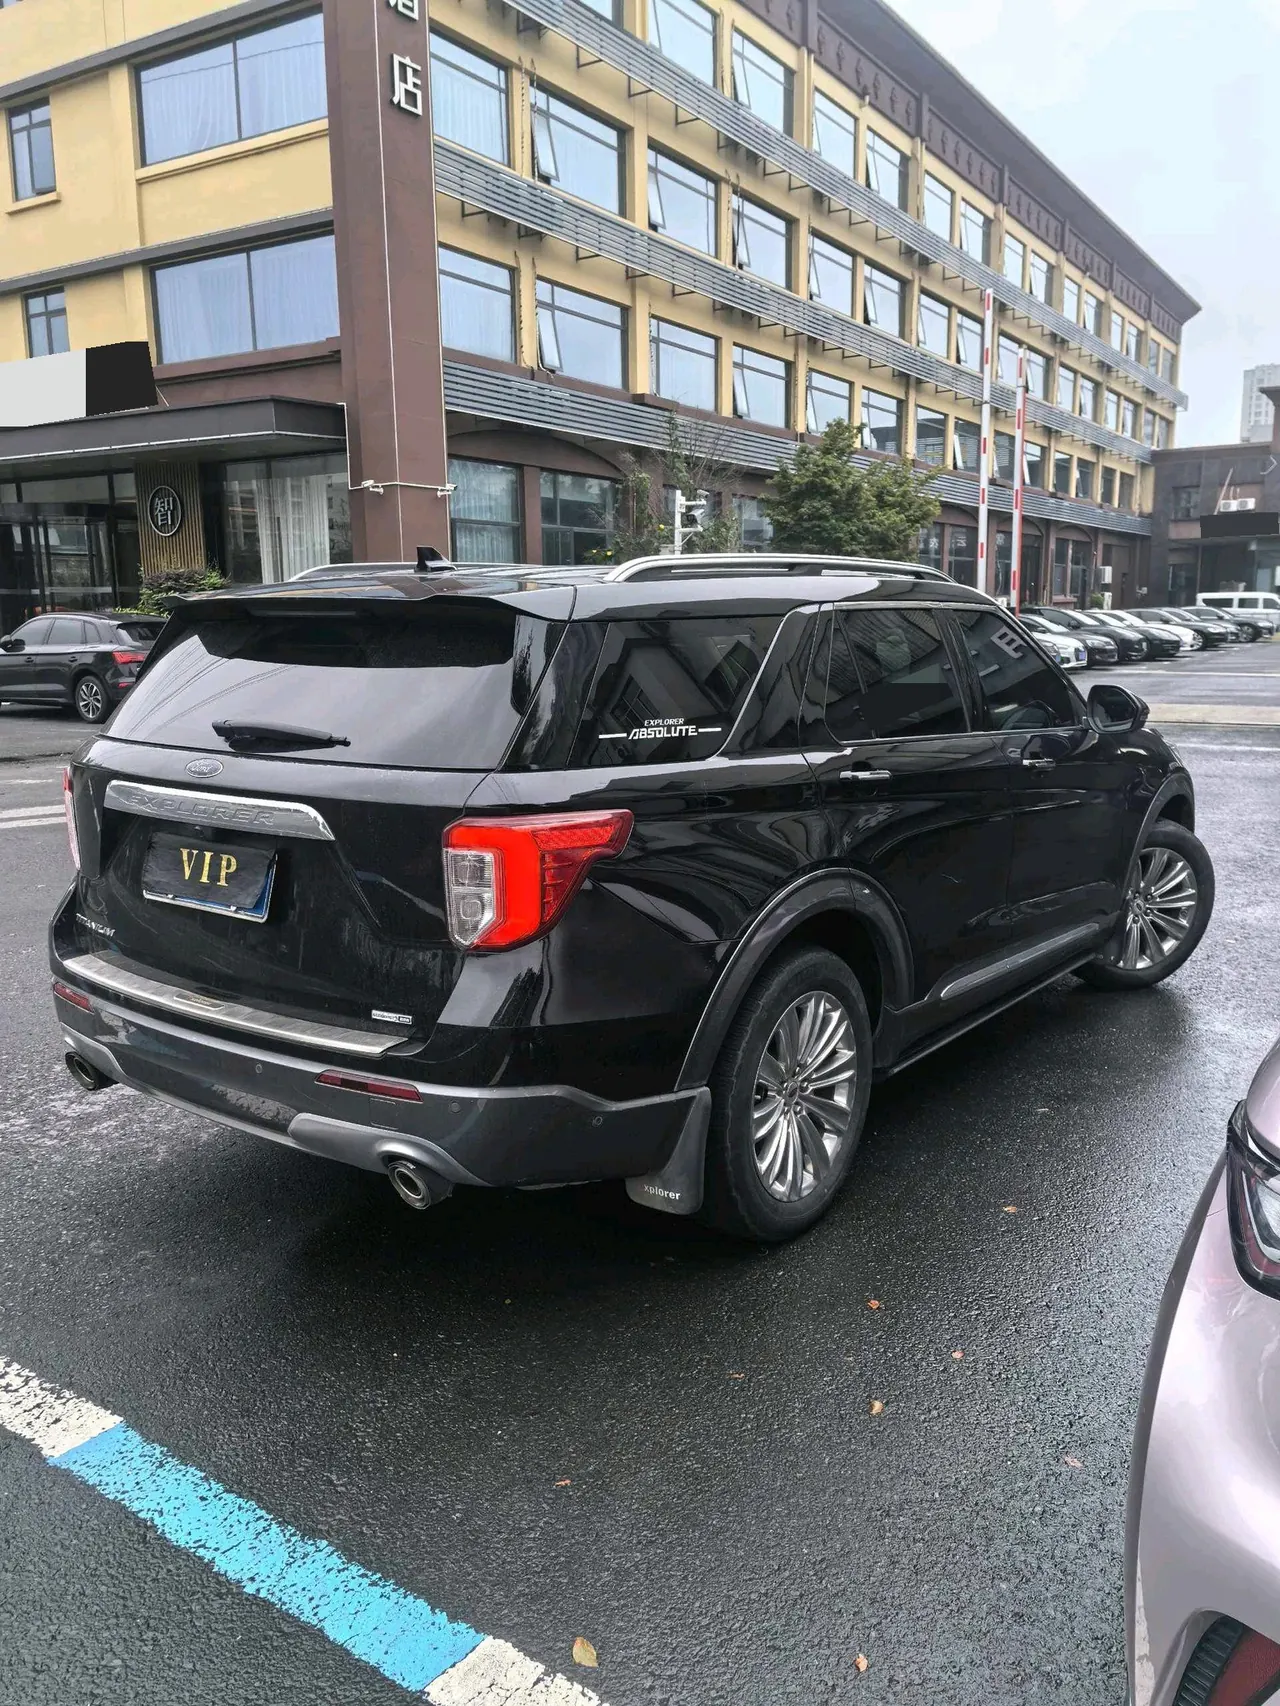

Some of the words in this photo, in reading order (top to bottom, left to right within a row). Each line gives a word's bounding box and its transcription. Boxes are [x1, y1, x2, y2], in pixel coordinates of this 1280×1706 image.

[154, 497, 173, 526] 智
[628, 725, 698, 740] ABSOLUTE
[644, 718, 685, 727] EXPLORER
[130, 794, 275, 826] EXPLORER
[179, 848, 238, 887] VIP
